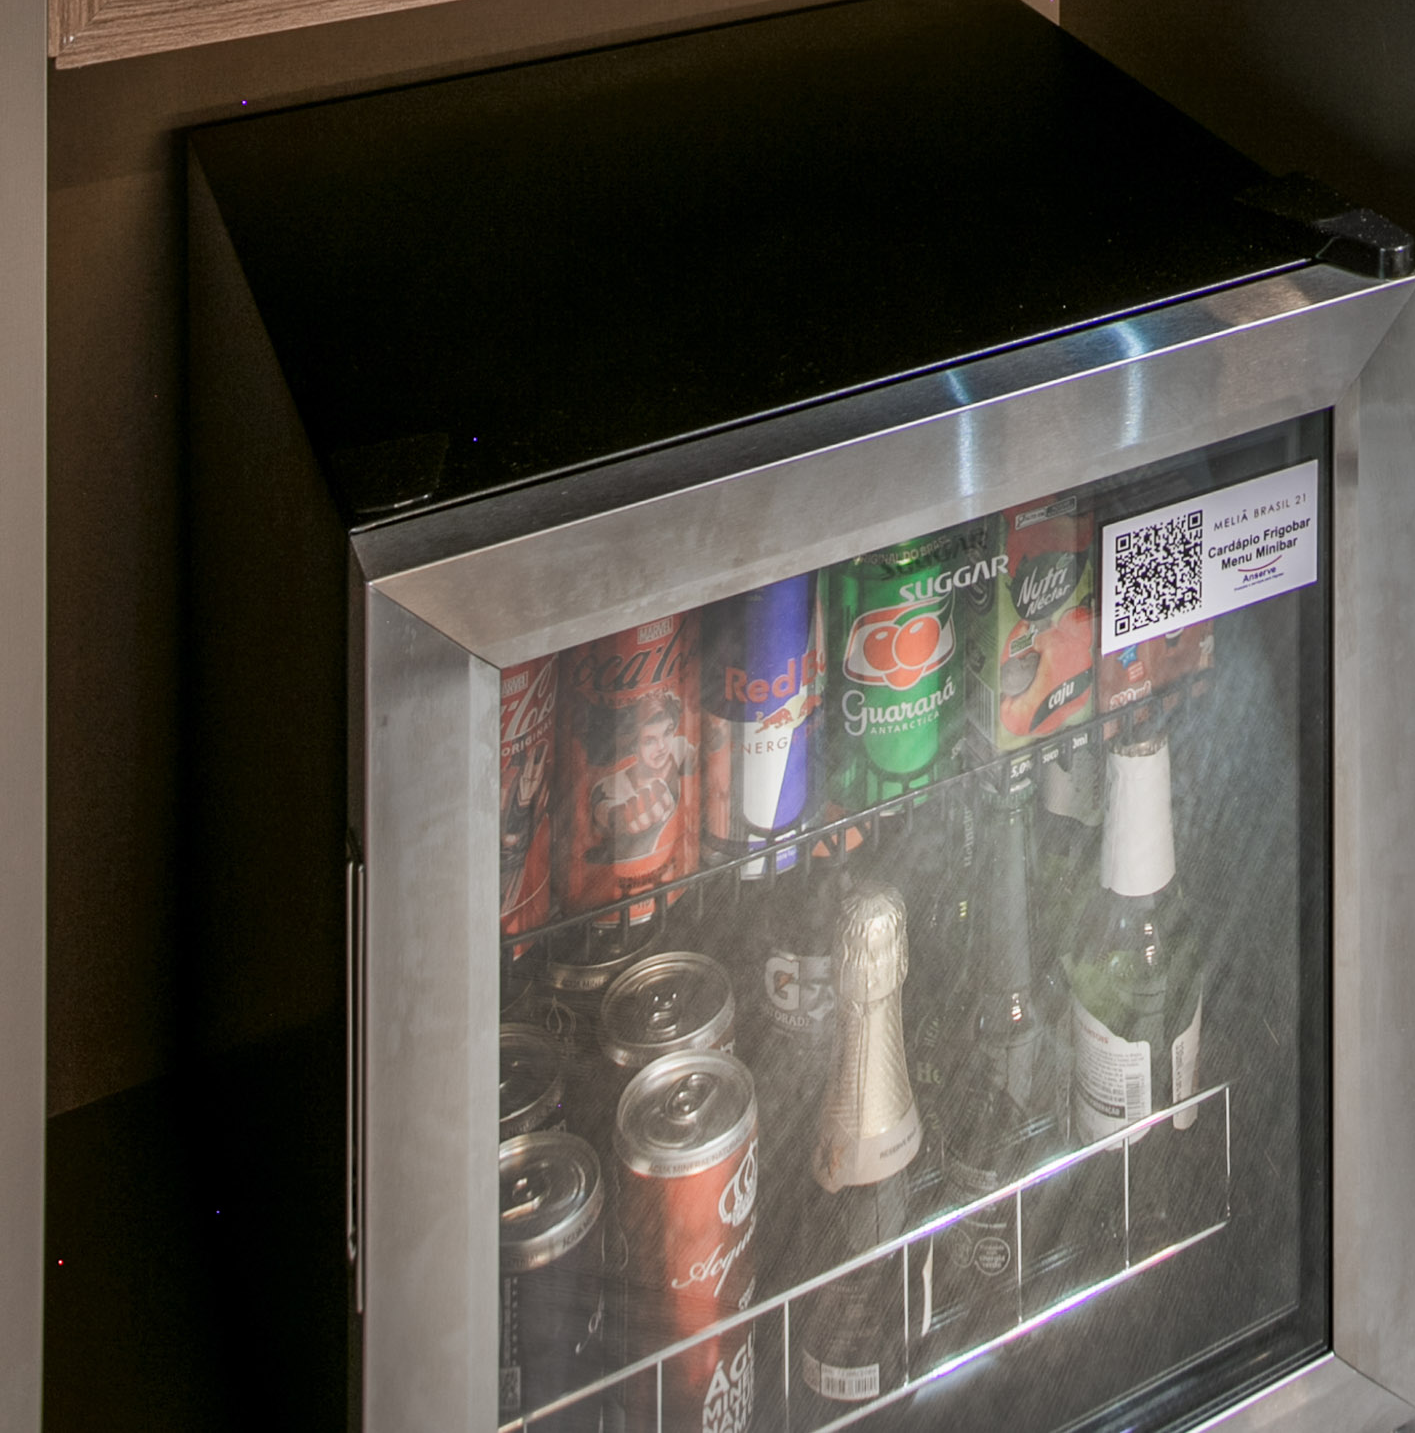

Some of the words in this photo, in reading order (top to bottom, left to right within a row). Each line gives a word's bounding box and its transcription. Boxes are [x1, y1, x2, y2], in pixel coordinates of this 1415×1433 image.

[1253, 499, 1291, 519] BRASIL
[1295, 493, 1307, 506] 21
[1208, 534, 1261, 559] Cardápio
[1263, 518, 1311, 542] Frigobar
[1221, 553, 1253, 571] Menu
[1256, 537, 1299, 560] Minibar
[899, 554, 1009, 602] SUGGAR
[1017, 566, 1068, 608] Nutri
[1243, 566, 1277, 584] Anserve
[725, 657, 797, 704] Red
[1048, 681, 1075, 710] caju
[842, 676, 955, 736] Guaraná
[870, 710, 940, 735] ANTARCTICA
